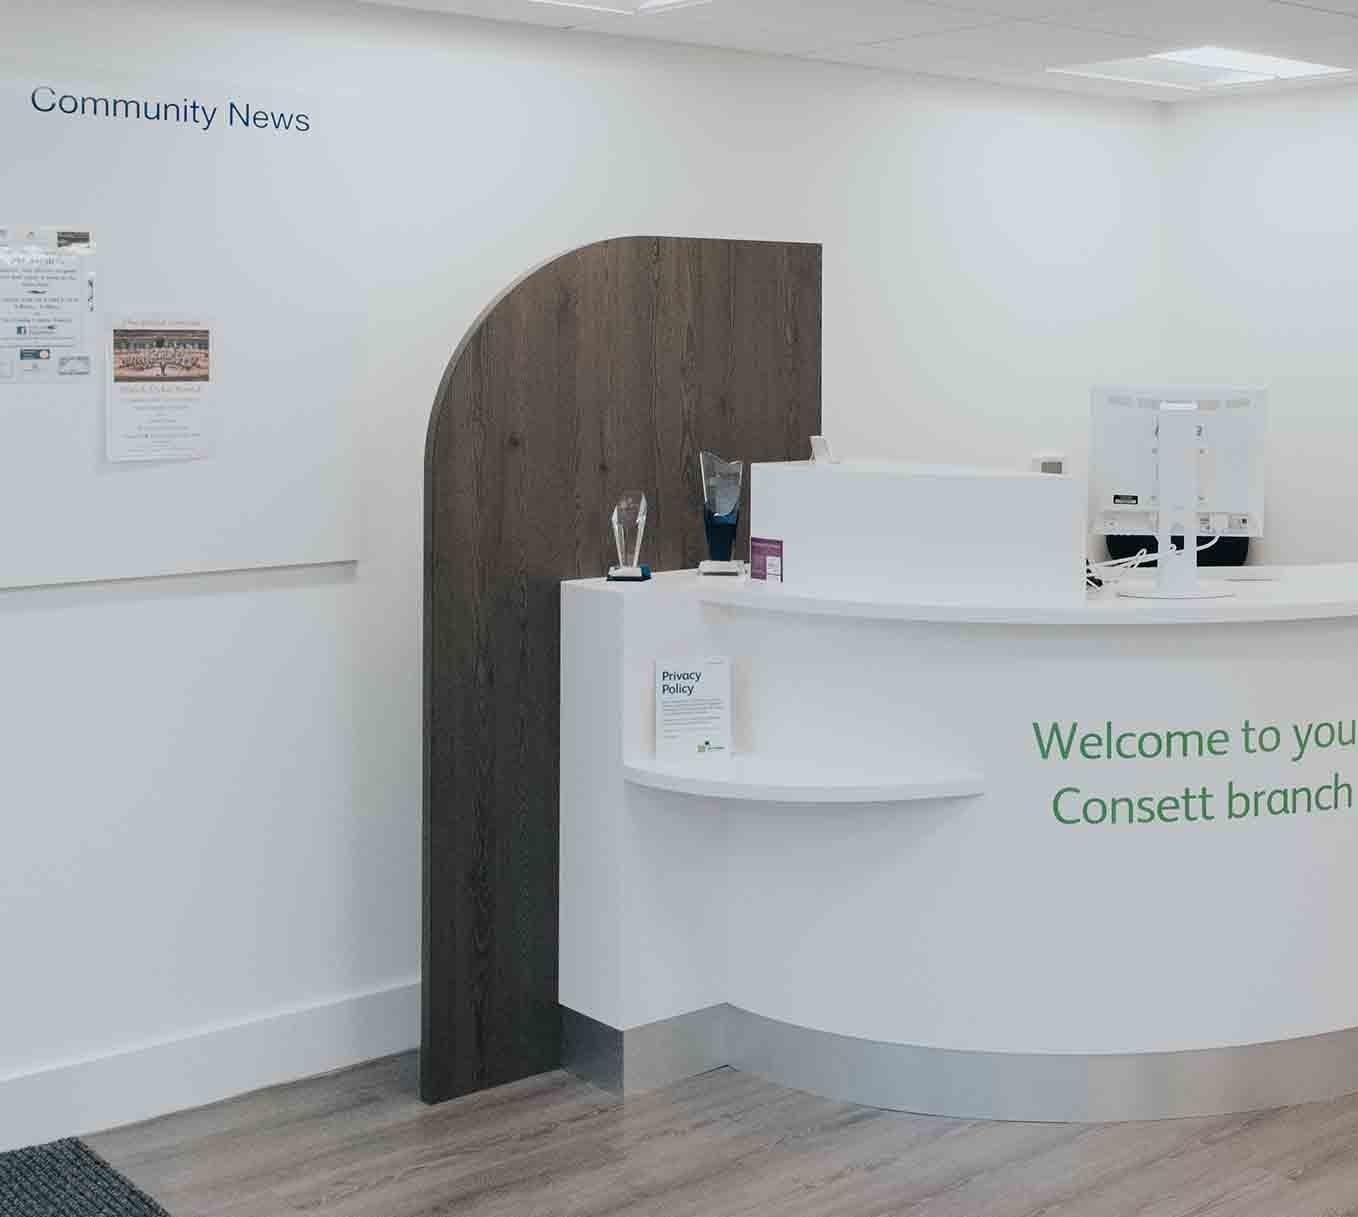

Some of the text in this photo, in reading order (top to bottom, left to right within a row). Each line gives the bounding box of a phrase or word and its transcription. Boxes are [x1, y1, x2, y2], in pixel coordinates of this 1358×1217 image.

[31, 86, 310, 132] Community News
[661, 671, 702, 682] Privacy
[661, 683, 695, 696] Policy
[1032, 720, 1230, 760] Welcome
[1241, 719, 1281, 753] to
[1052, 771, 1353, 825] Consett branch
